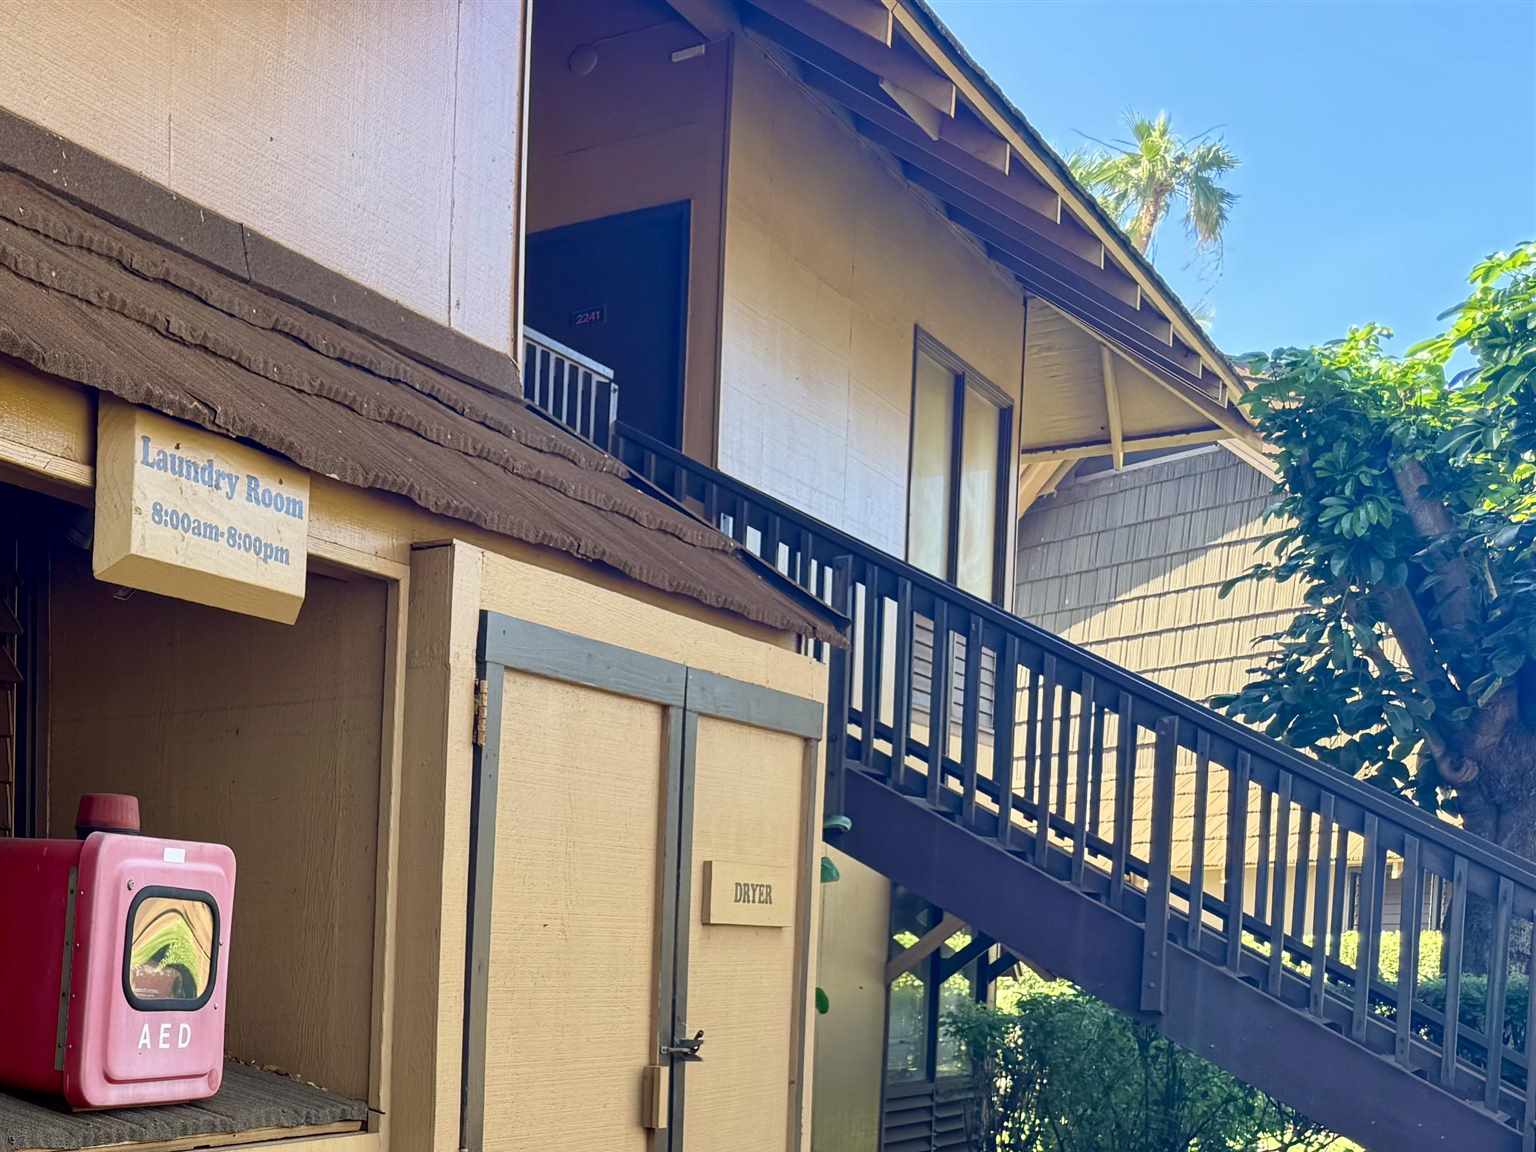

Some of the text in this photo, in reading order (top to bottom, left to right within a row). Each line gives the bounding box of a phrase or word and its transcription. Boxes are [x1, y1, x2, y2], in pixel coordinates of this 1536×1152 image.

[140, 435, 304, 520] Laundry Room
[150, 501, 290, 566] 8:00am-8:00pm
[734, 882, 772, 904] DRYER
[138, 1023, 192, 1049] AED
